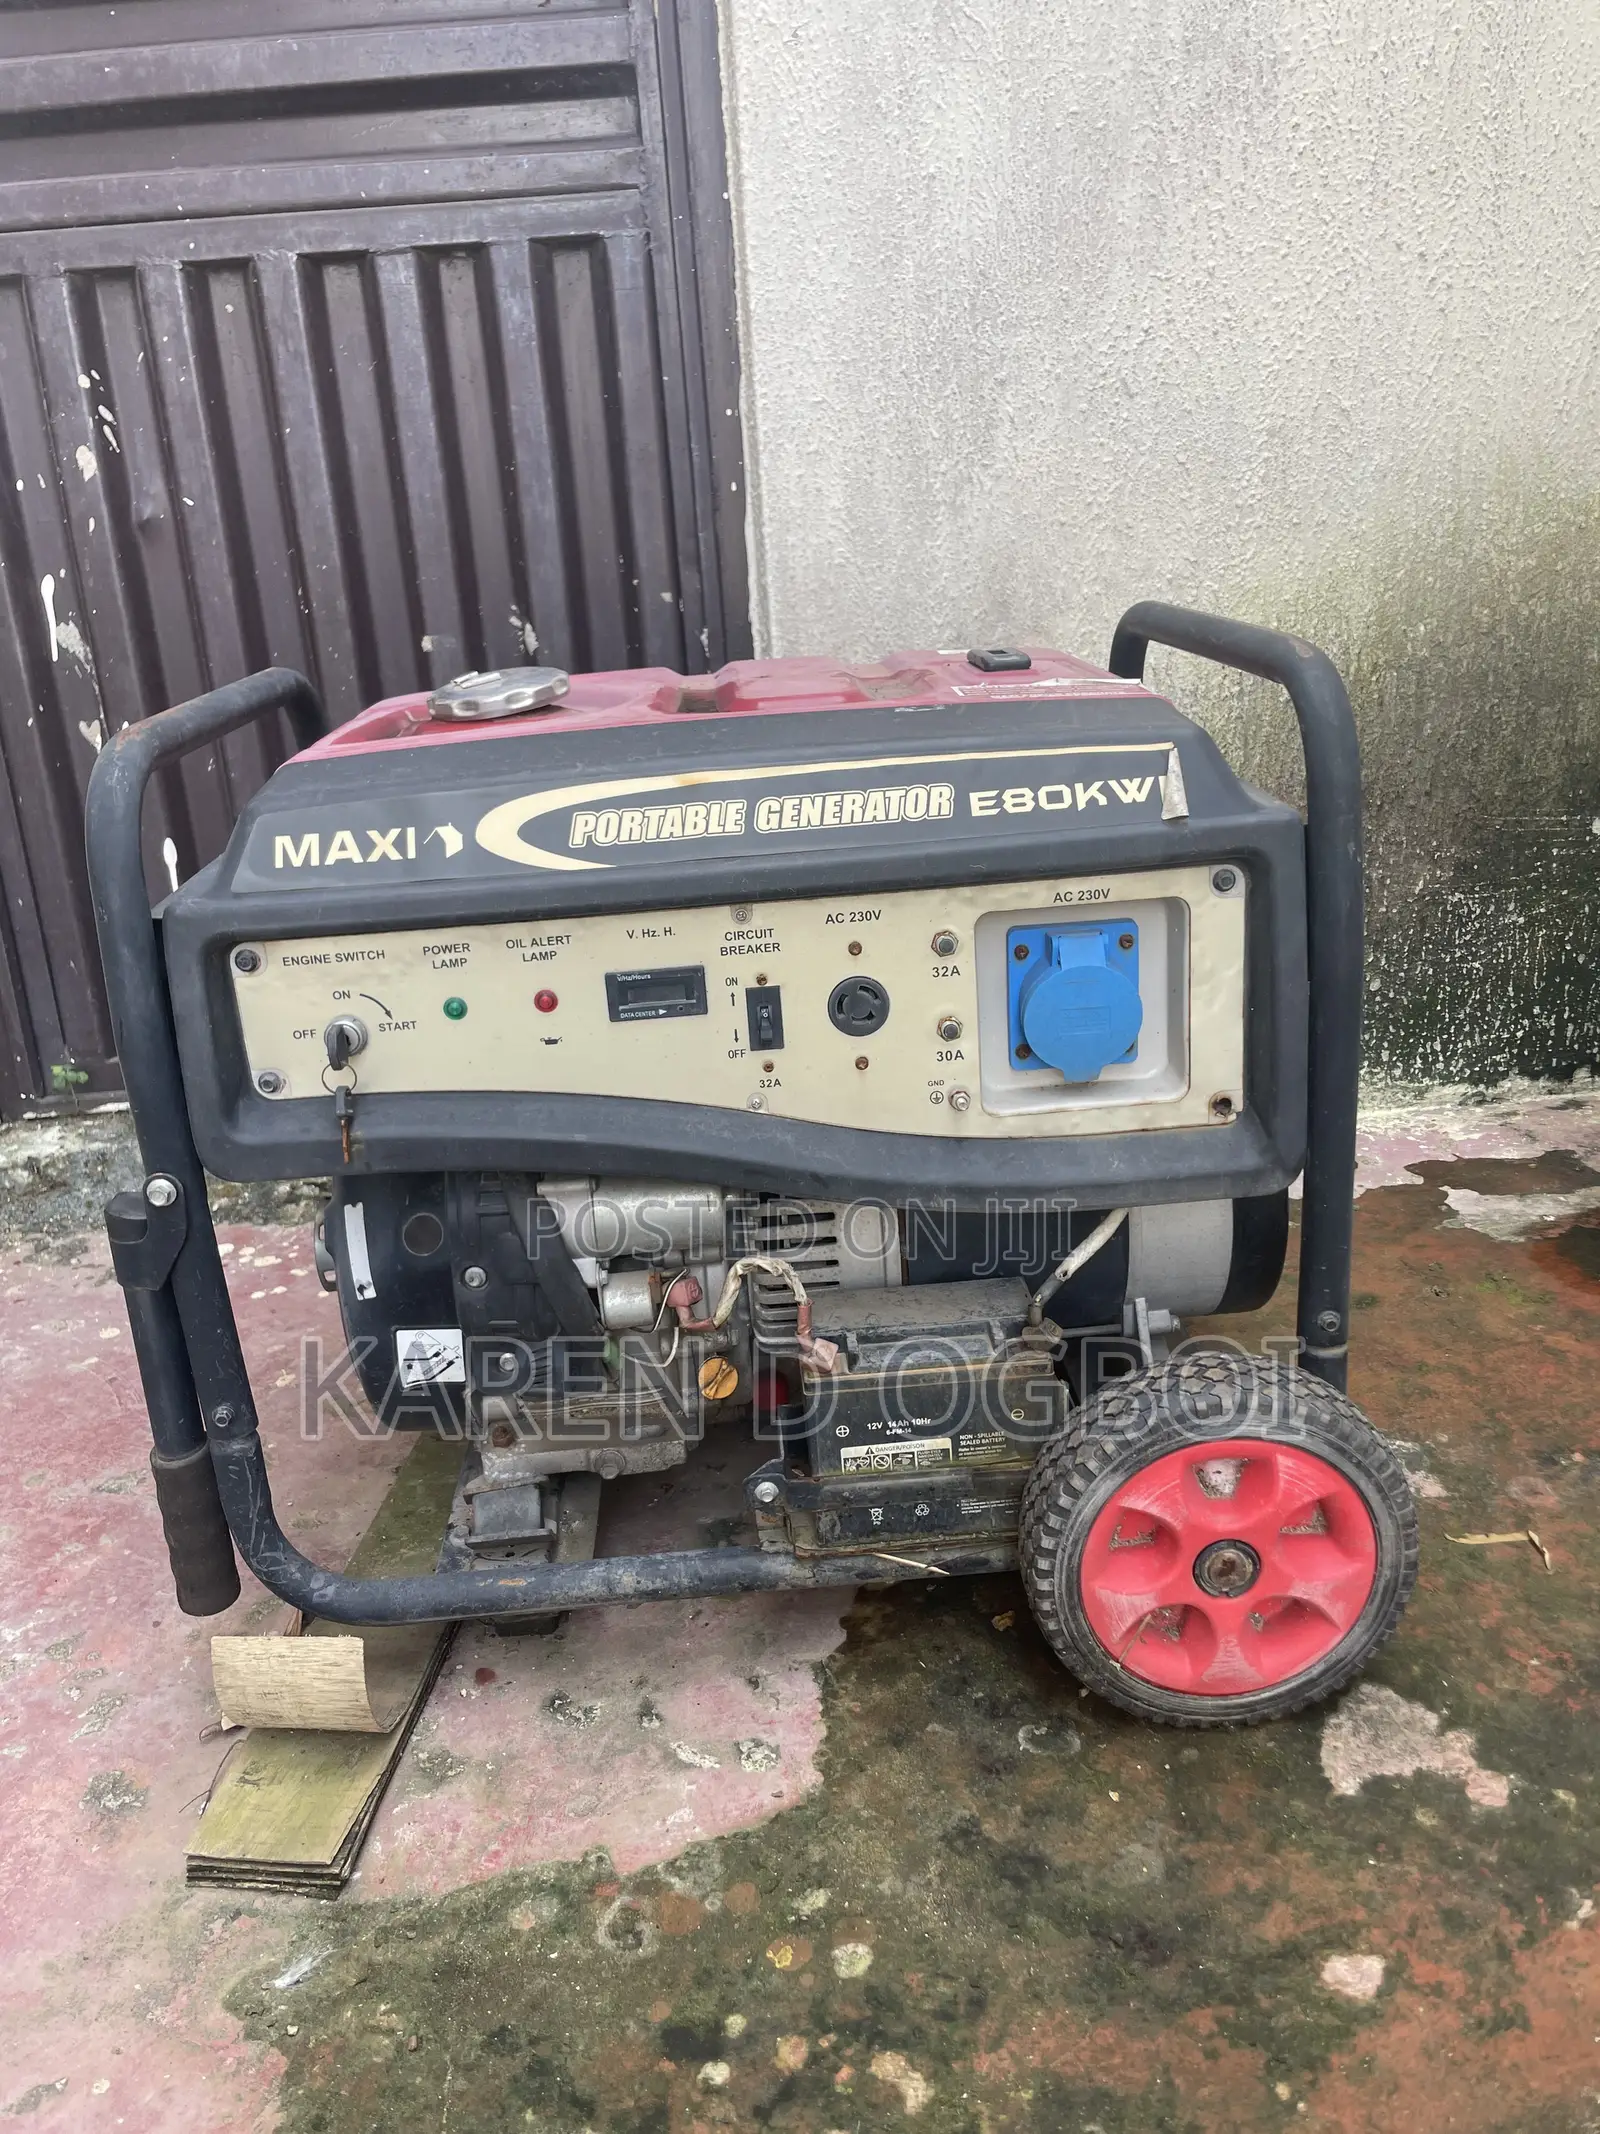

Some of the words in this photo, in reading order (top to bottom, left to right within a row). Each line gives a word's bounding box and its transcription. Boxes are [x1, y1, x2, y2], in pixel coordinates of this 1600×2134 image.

[569, 799, 745, 848] PORTABLE
[755, 783, 955, 834] GENERATOR
[274, 827, 416, 869] MAXI
[1053, 891, 1073, 904] AC
[1078, 888, 1111, 902] 230V
[825, 912, 845, 925] AC
[850, 909, 882, 923] 230V
[505, 938, 527, 949] OIL
[529, 934, 572, 948] ALERT
[724, 928, 775, 942] CIRCUIT
[422, 942, 471, 956] POWER
[720, 942, 781, 956] BREAKER
[282, 953, 332, 967] ENGINE
[335, 949, 385, 963] SWITCH
[522, 950, 558, 963] LAMP
[432, 957, 468, 970] LAMP
[932, 965, 961, 978] 32A
[725, 976, 738, 987] ON
[332, 990, 351, 1000] ON
[620, 1011, 634, 1019] DATA
[635, 1010, 656, 1018] CENTER
[378, 1020, 417, 1032] START
[292, 1029, 316, 1040] OFF
[727, 1048, 746, 1060] OFF
[936, 1049, 965, 1062] 30A
[759, 1078, 782, 1088] 32A
[927, 1079, 945, 1087] GND
[867, 1421, 883, 1430] 12V
